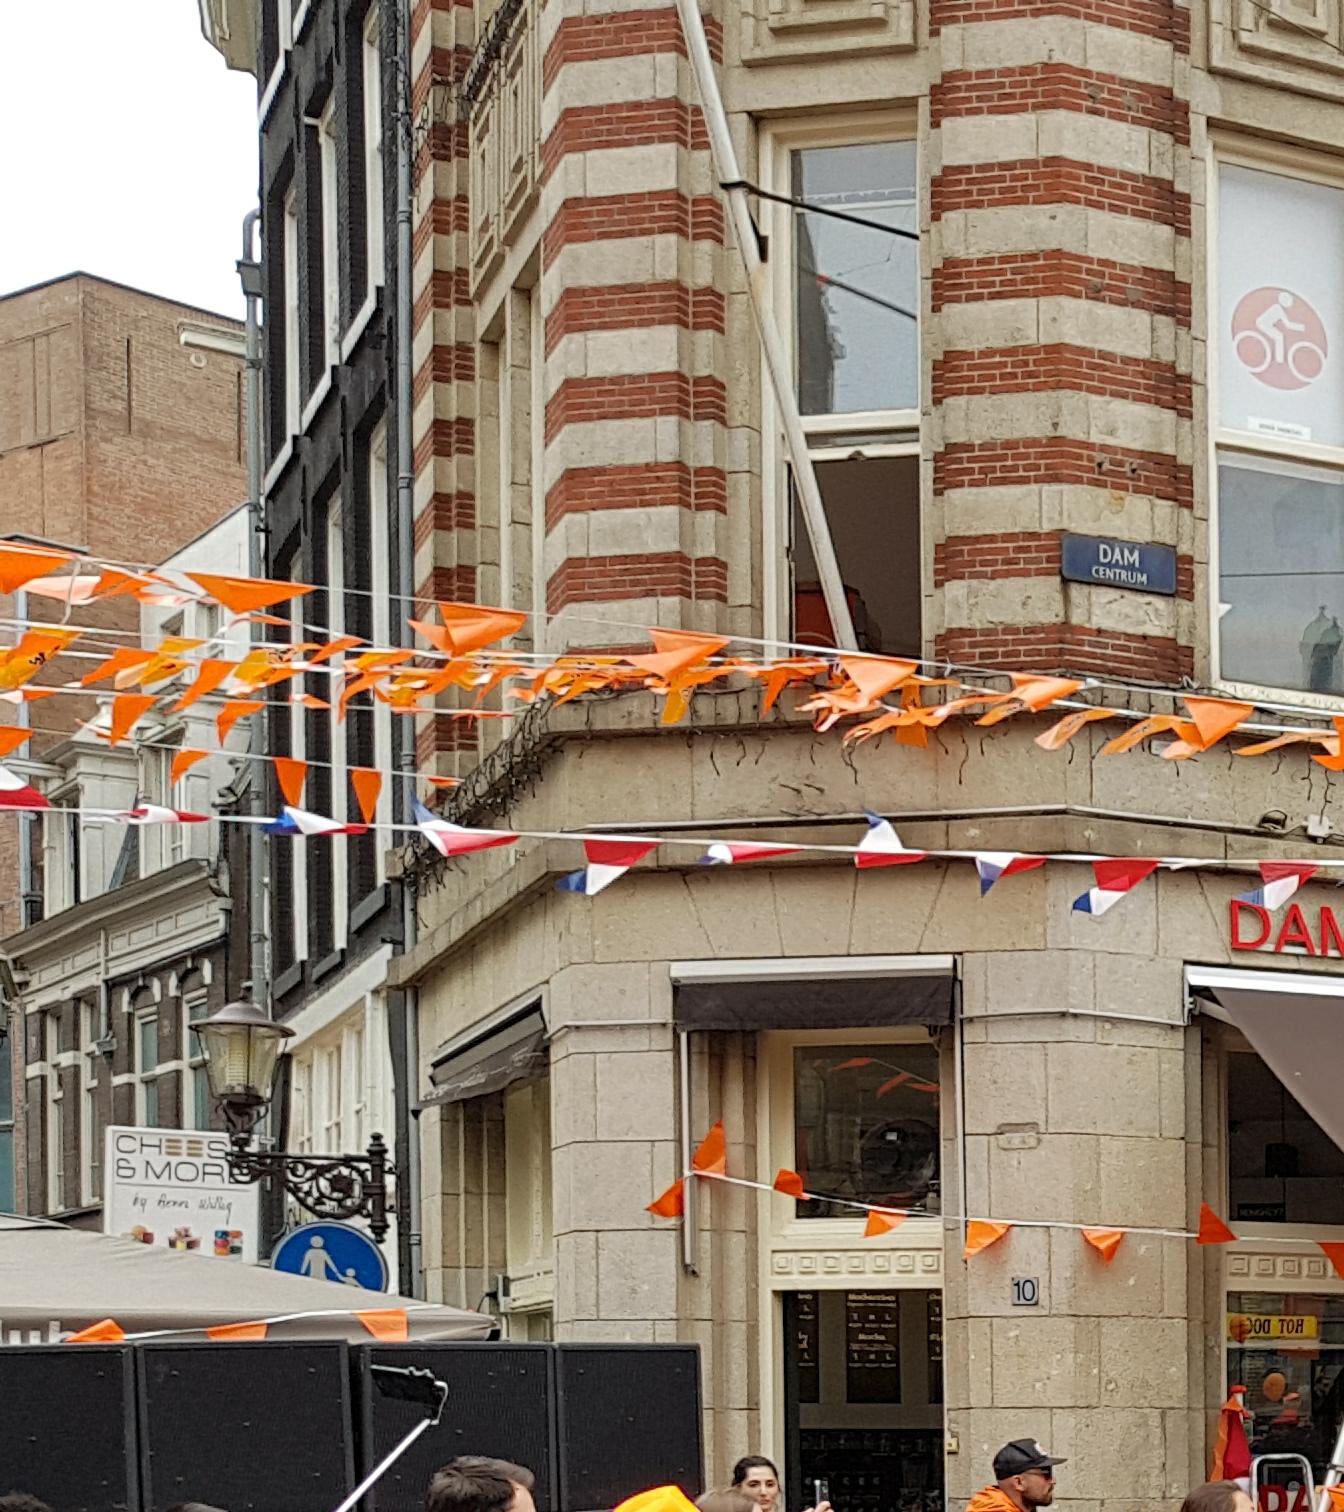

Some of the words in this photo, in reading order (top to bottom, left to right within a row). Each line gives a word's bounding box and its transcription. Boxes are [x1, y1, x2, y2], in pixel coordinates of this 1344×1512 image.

[1098, 543, 1141, 568] DAM
[1091, 565, 1148, 586] CENTRUM
[115, 1134, 228, 1160] CHEES
[116, 1157, 137, 1179] &
[145, 1160, 226, 1184] MOR
[1013, 1279, 1036, 1302] 10
